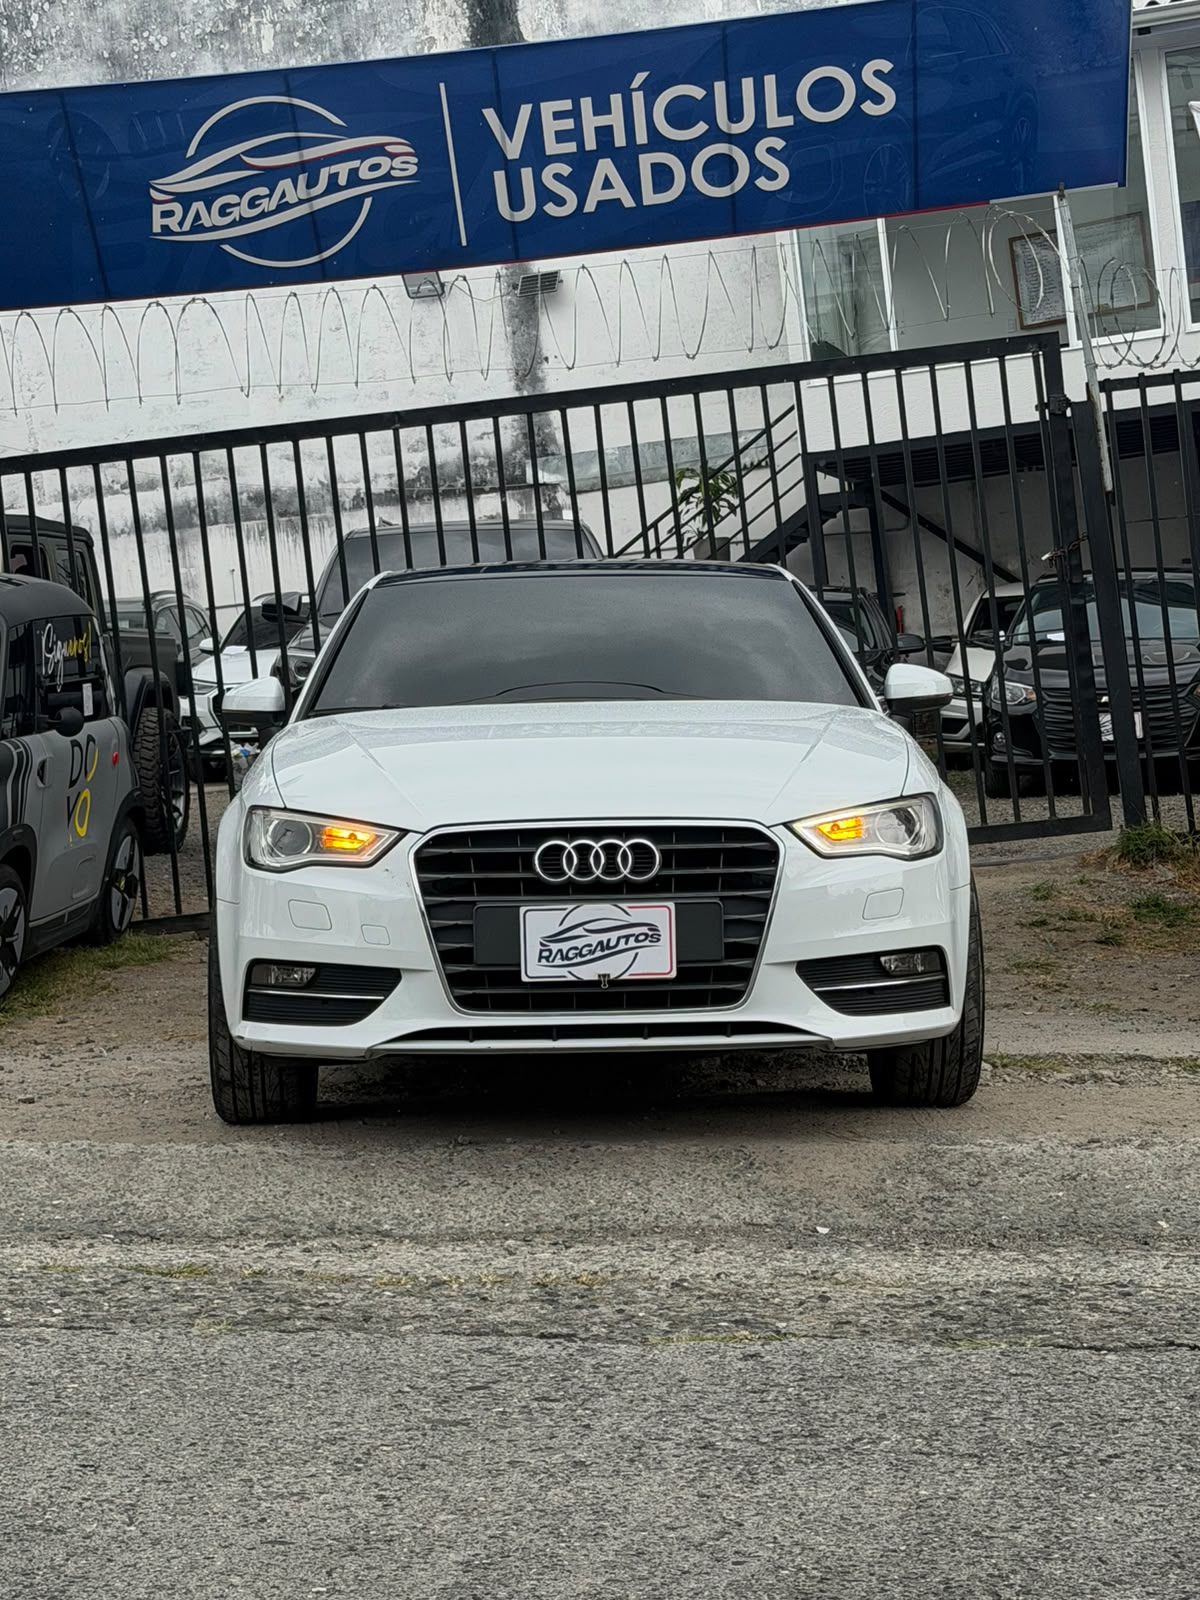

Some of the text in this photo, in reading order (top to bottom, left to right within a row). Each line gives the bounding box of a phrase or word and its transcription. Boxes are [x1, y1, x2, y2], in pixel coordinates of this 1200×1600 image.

[482, 60, 896, 160] VEHÍCULOS
[152, 156, 418, 233] RAGGAUTOS
[493, 137, 790, 222] USADOS
[537, 931, 662, 964] RAGGAUTOS
